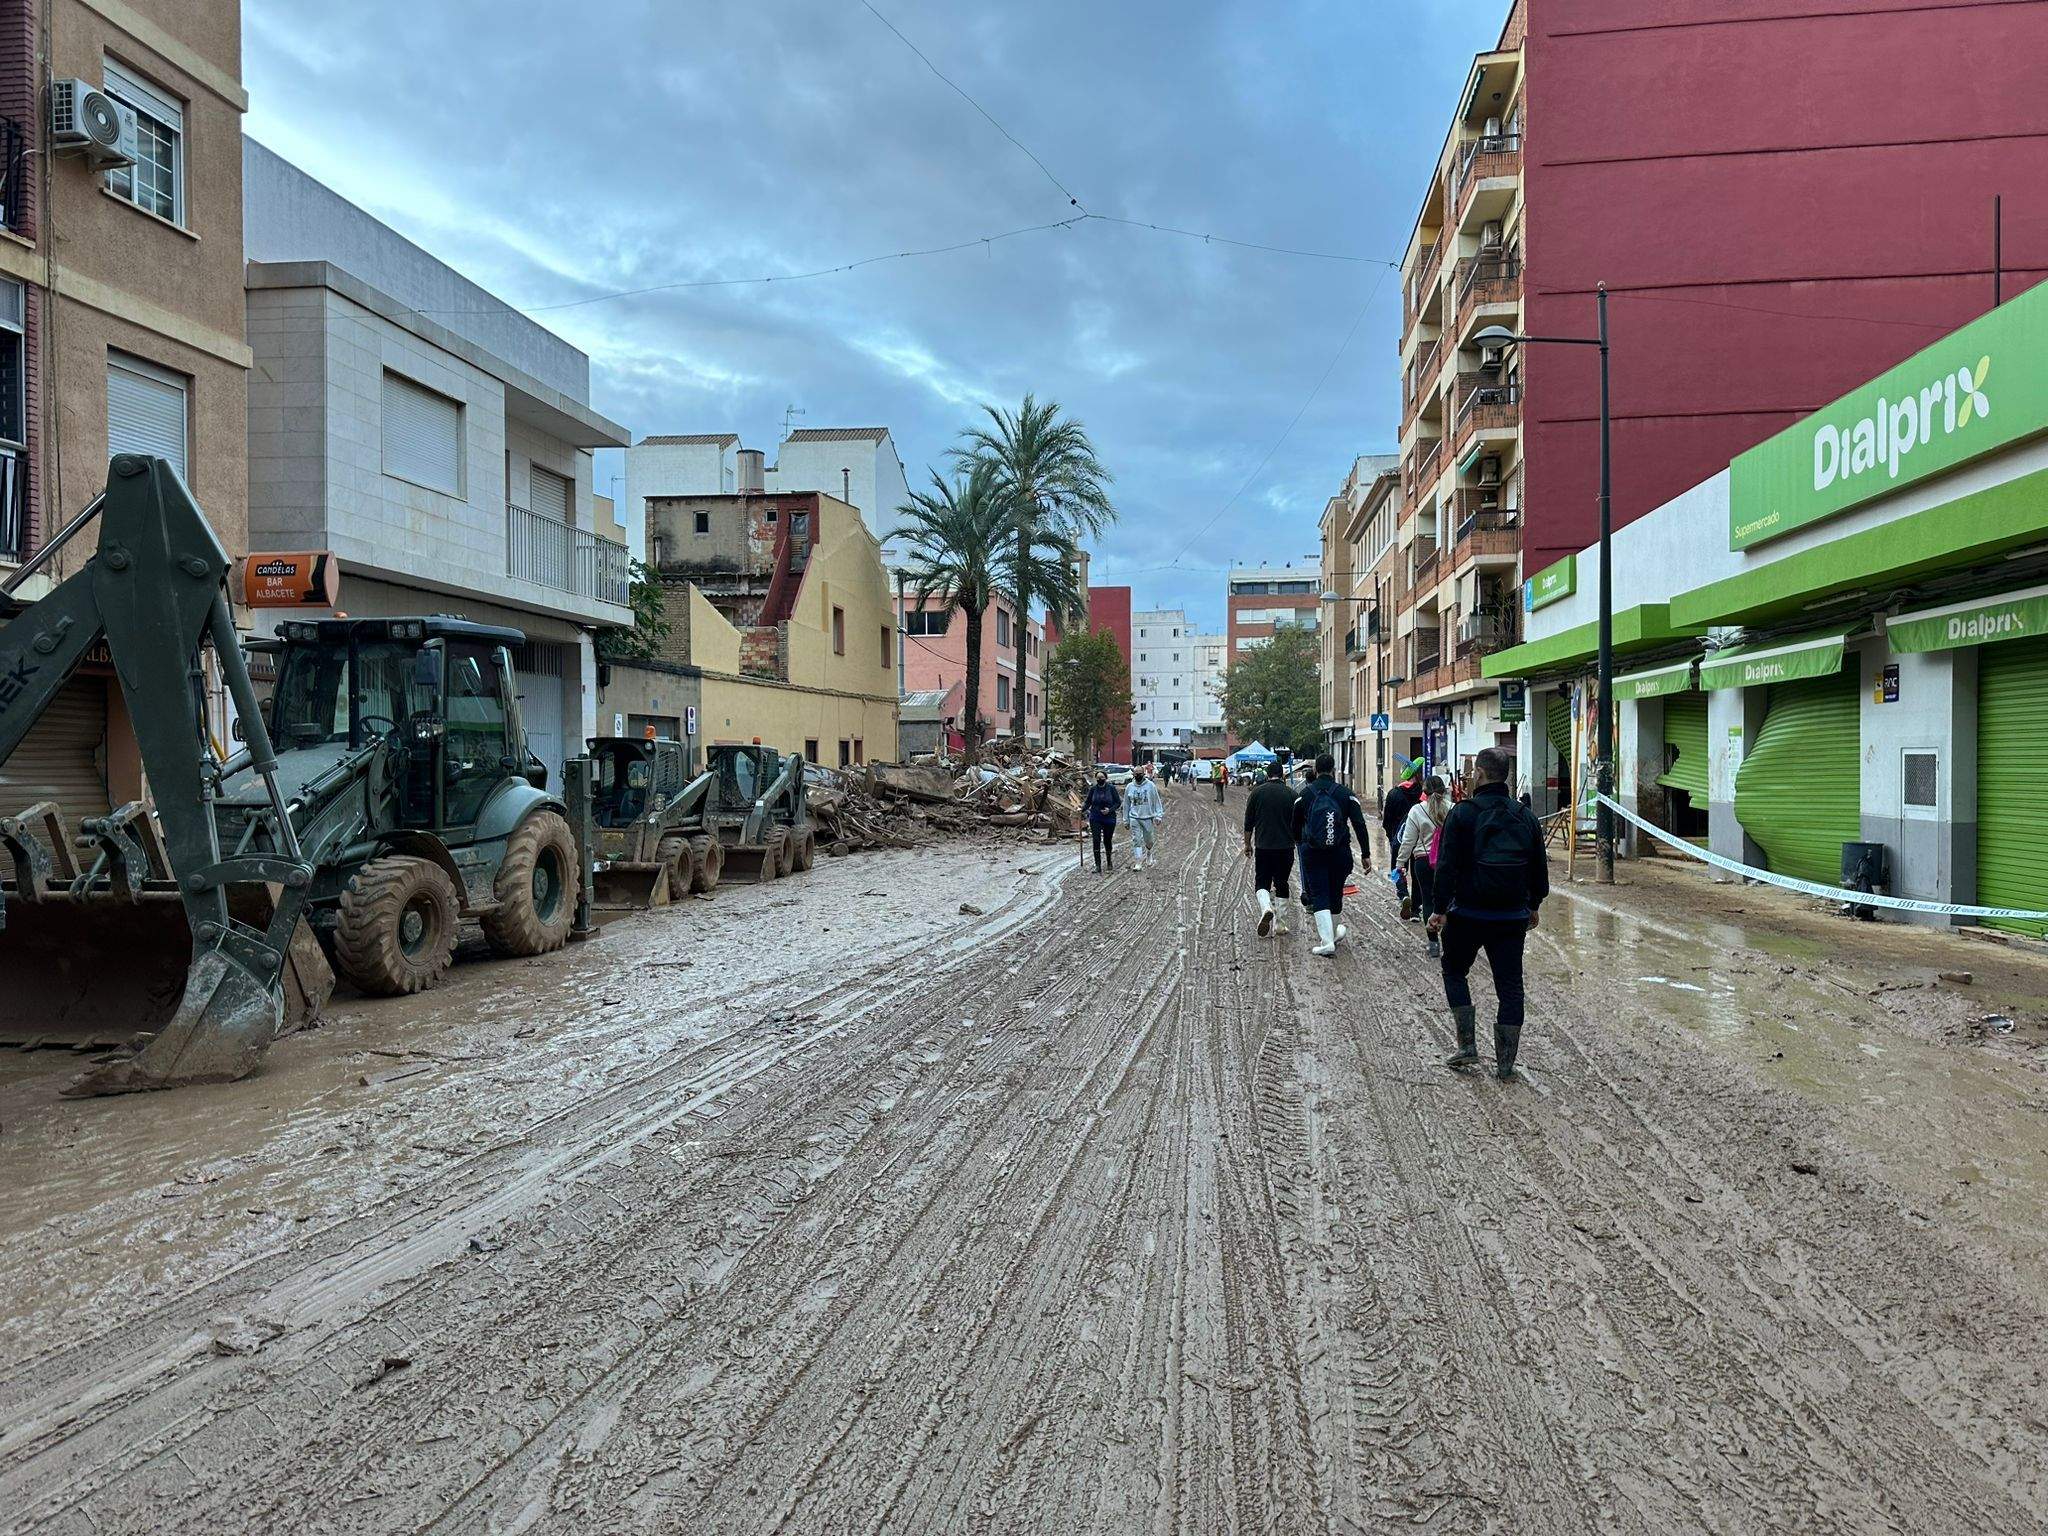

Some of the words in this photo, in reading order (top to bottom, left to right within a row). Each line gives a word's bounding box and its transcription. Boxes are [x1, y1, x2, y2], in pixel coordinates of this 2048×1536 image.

[1813, 355, 1990, 492] Dialprix
[1734, 508, 1780, 539] Supermercado
[257, 565, 295, 575] CANDELAS
[256, 588, 295, 598] ALBACETE
[266, 577, 283, 587] BAR
[1948, 612, 2024, 640] Dialprix
[1745, 662, 1785, 681] Dialprix
[1325, 811, 1335, 846] Reebok
